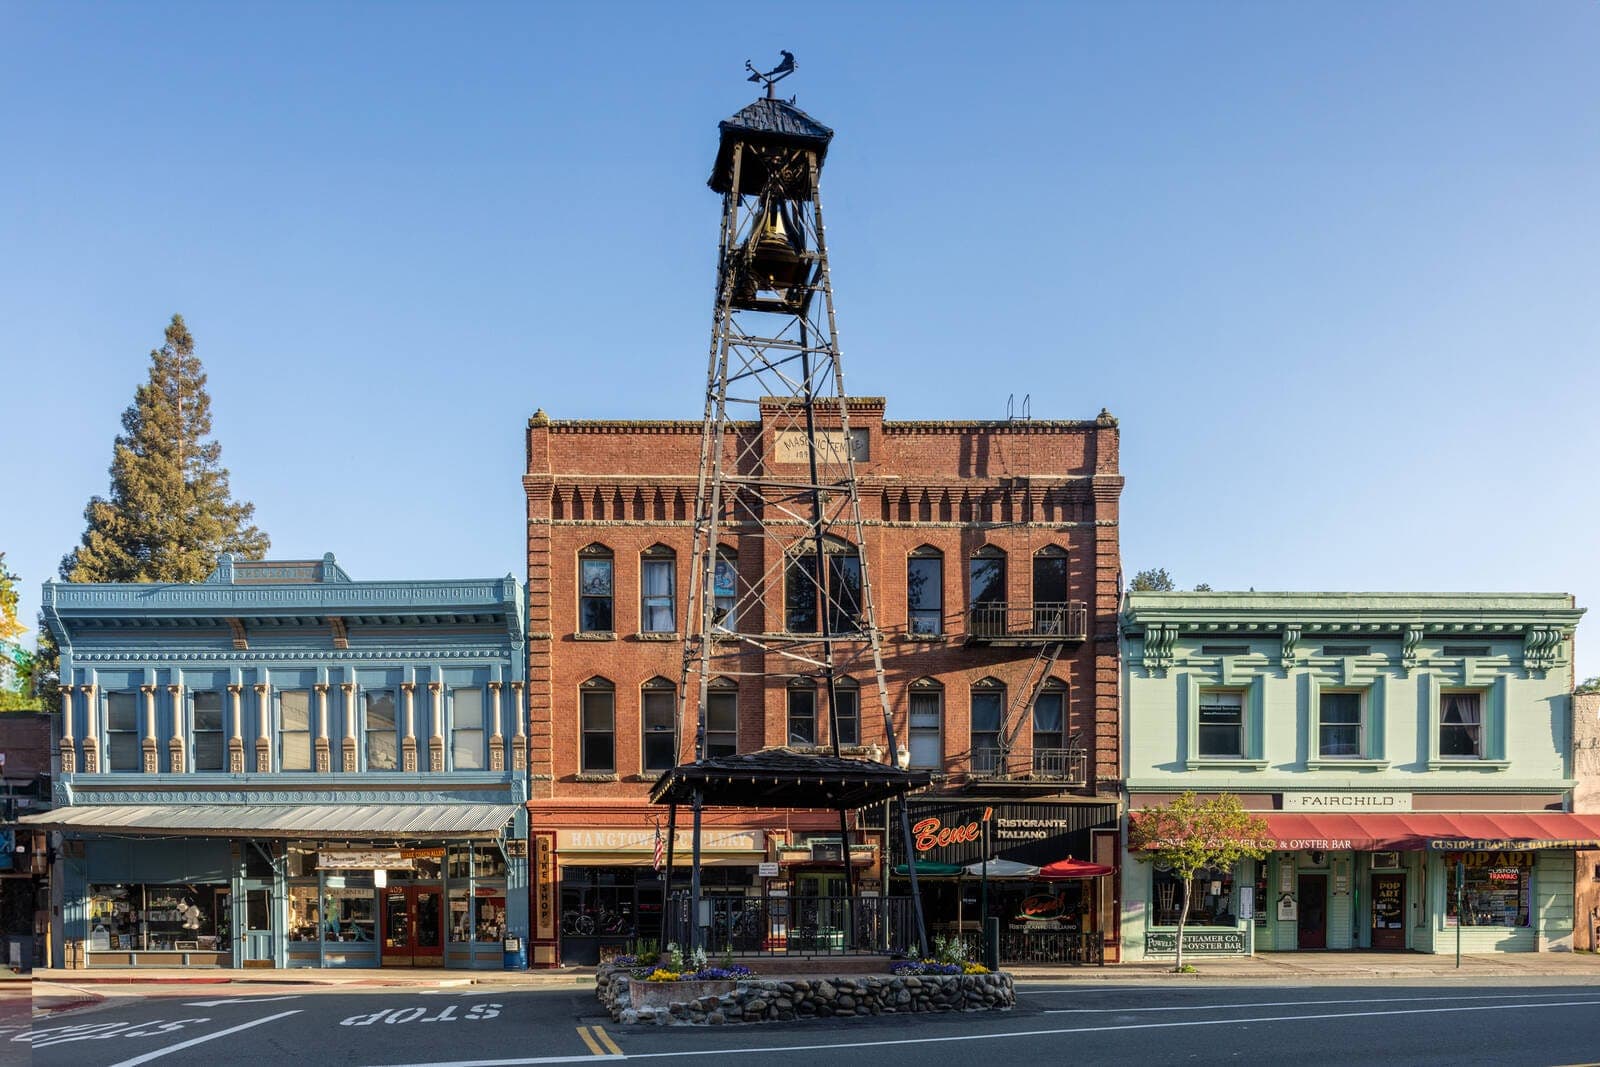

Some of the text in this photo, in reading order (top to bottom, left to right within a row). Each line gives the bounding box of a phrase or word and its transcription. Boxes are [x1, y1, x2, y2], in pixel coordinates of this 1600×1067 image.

[829, 439, 863, 453] TEMLE
[1301, 796, 1394, 806] FAIRCHILD
[997, 818, 1067, 828] RISTORANTE
[997, 830, 1047, 839] ITALIANO
[679, 832, 746, 847] CLERY
[1280, 840, 1287, 849] &
[1290, 839, 1329, 849] OYSTER
[1332, 839, 1352, 849] BAR
[1431, 840, 1475, 849] CUSTOM
[1379, 882, 1400, 890] POP
[1379, 890, 1400, 898] ART
[1225, 935, 1240, 943] CO.
[1188, 942, 1222, 950] OYSTER
[1224, 942, 1241, 950] BAR
[340, 1004, 503, 1026] STOP
